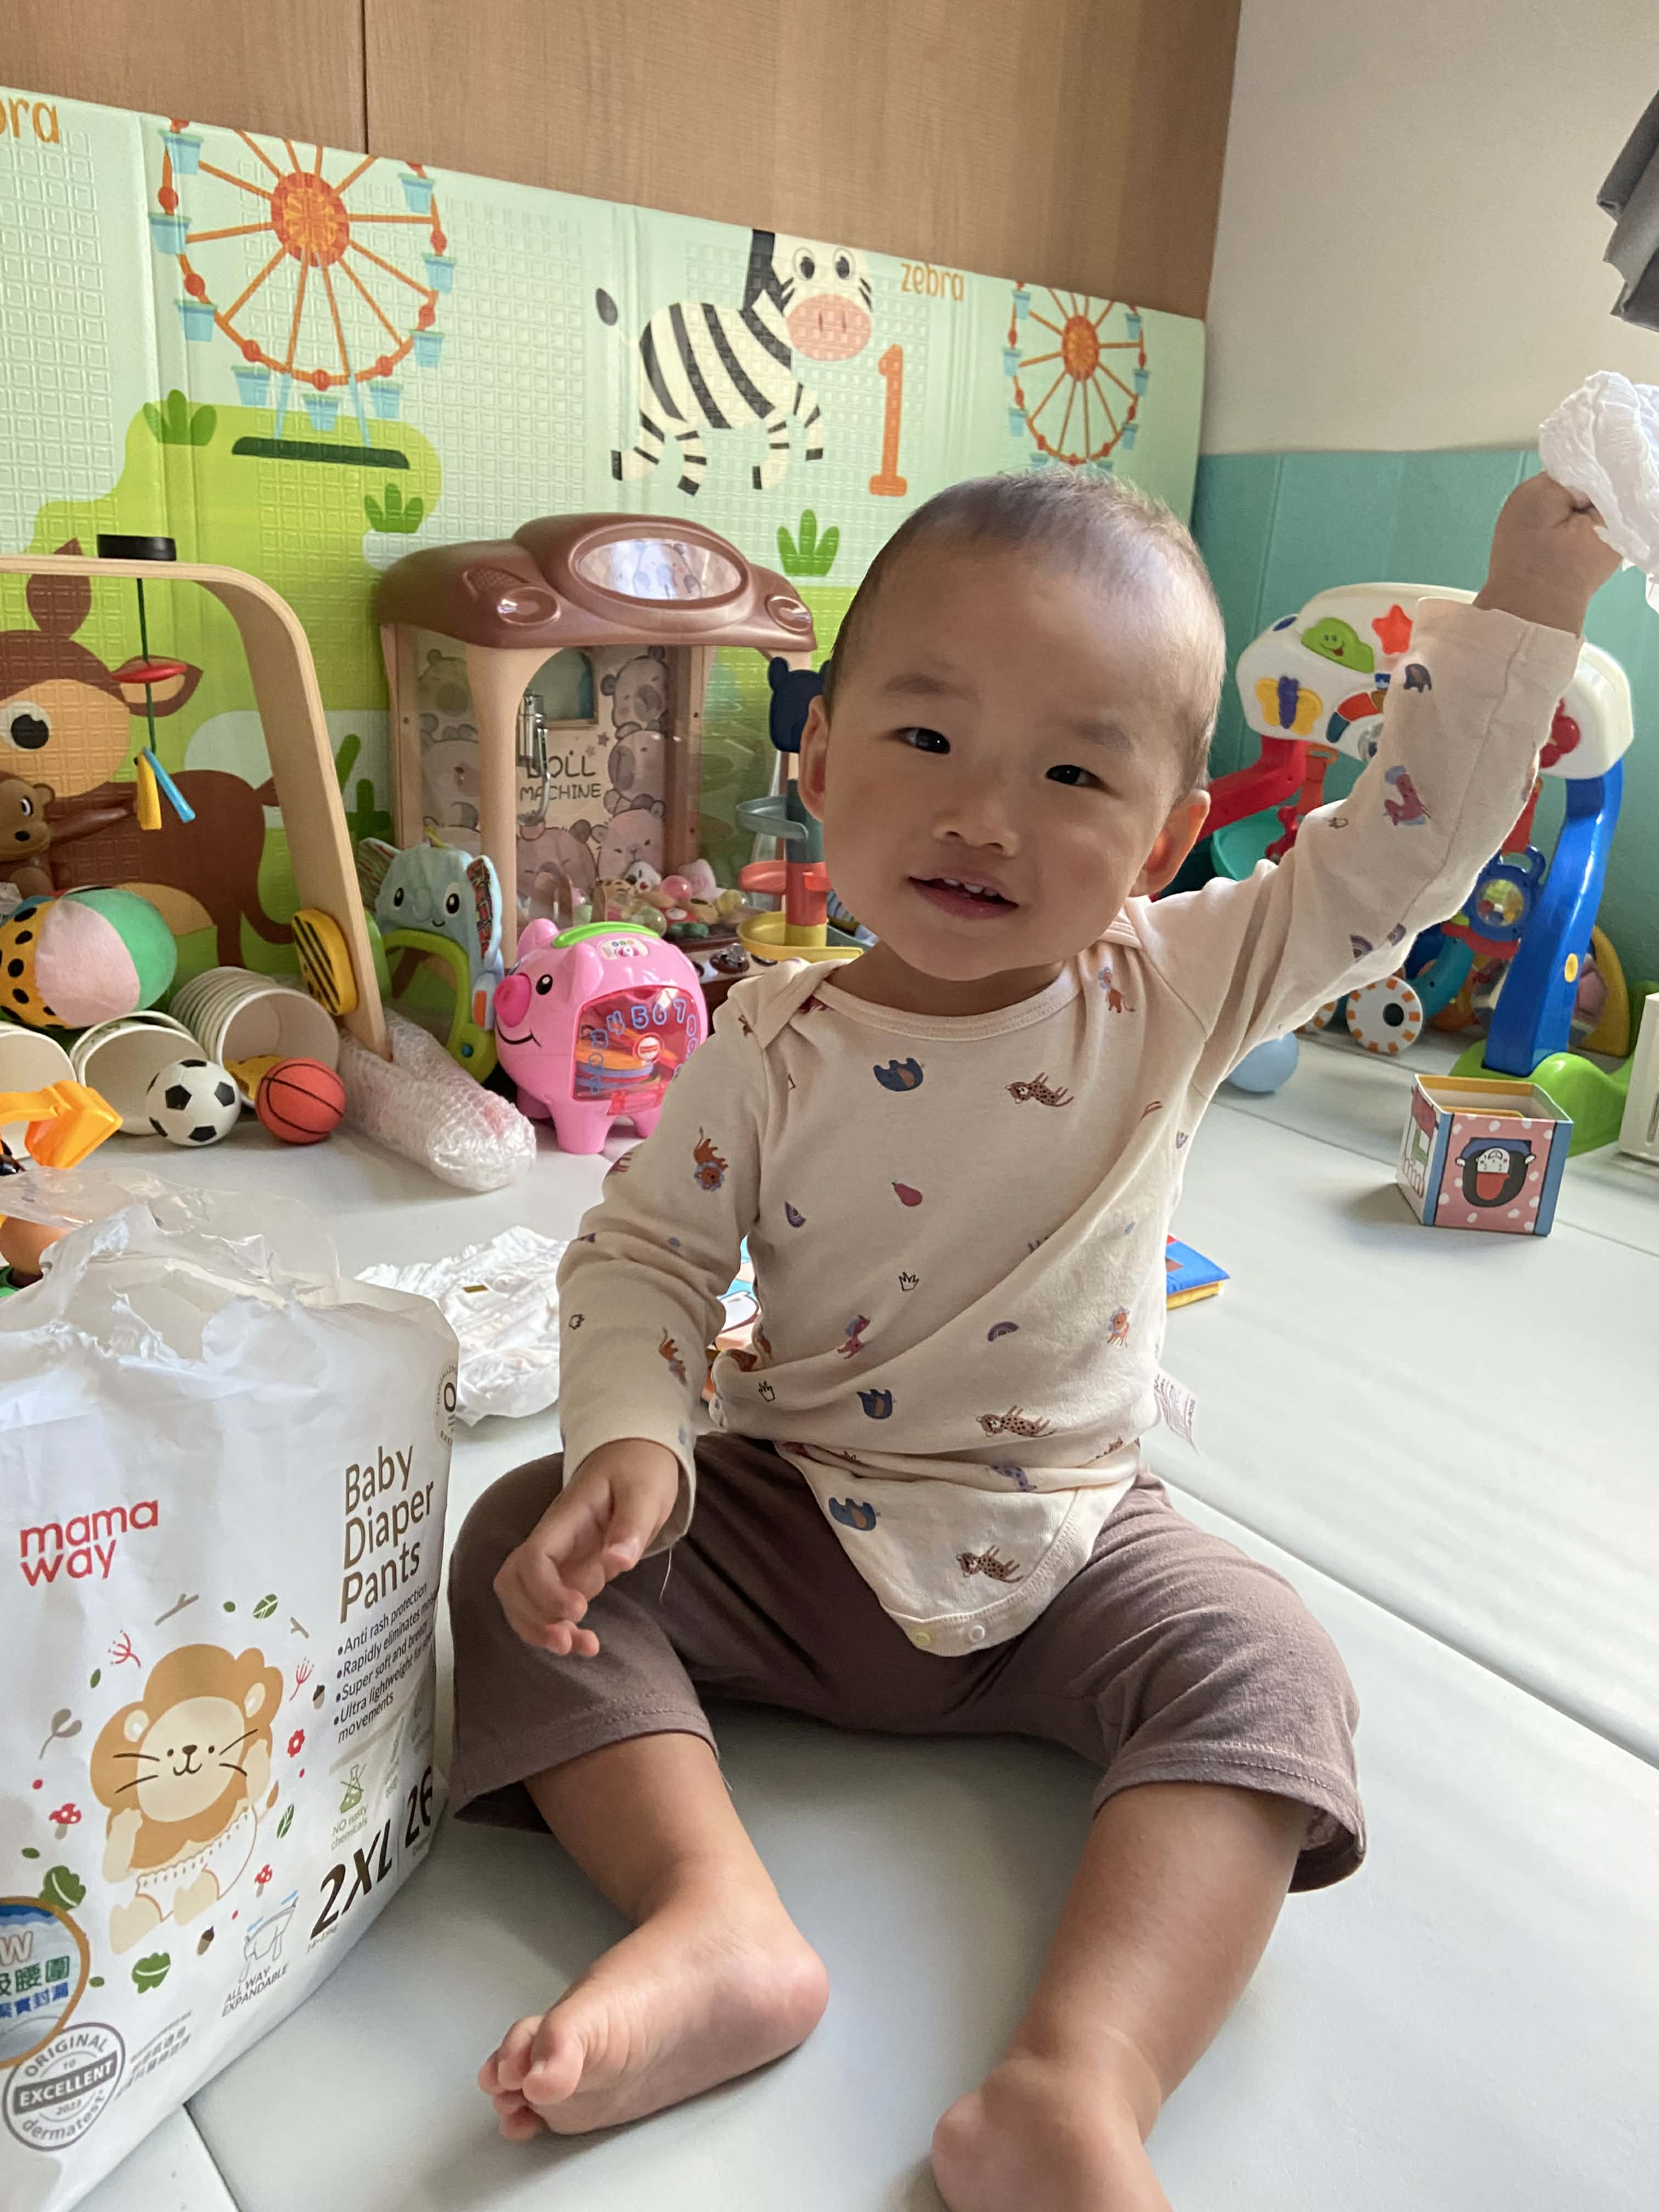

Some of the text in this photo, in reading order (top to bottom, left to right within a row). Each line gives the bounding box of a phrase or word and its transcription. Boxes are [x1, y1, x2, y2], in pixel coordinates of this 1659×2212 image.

[900, 262, 964, 302] zebra
[868, 343, 907, 497] 1
[520, 783, 601, 802] MACHINE
[346, 1445, 413, 1516] Baby
[20, 1500, 158, 1558] mama
[344, 1481, 433, 1570] Diaper
[20, 1539, 116, 1586] way
[340, 1541, 420, 1624] Pants
[343, 1643, 382, 1677] Rapidly
[383, 1610, 420, 1650] eliminates
[344, 1627, 368, 1655] Anti
[370, 1613, 388, 1639] rash
[391, 1582, 427, 1625] protection
[340, 1698, 366, 1723] Ultra
[369, 1654, 413, 1703] lightweight
[342, 1671, 373, 1700] Super
[375, 1654, 391, 1679] soft
[392, 1637, 407, 1663] and
[338, 1691, 393, 1743] movements
[331, 1817, 369, 1851] chemicals
[333, 1819, 347, 1837] NO
[311, 1818, 392, 1940] 2XL
[222, 1963, 289, 2017] EXPANDABLE
[224, 1965, 270, 2005] ALL WAY
[20, 2059, 113, 2107] EXCELLENT
[25, 2033, 108, 2077] ORIGINAL
